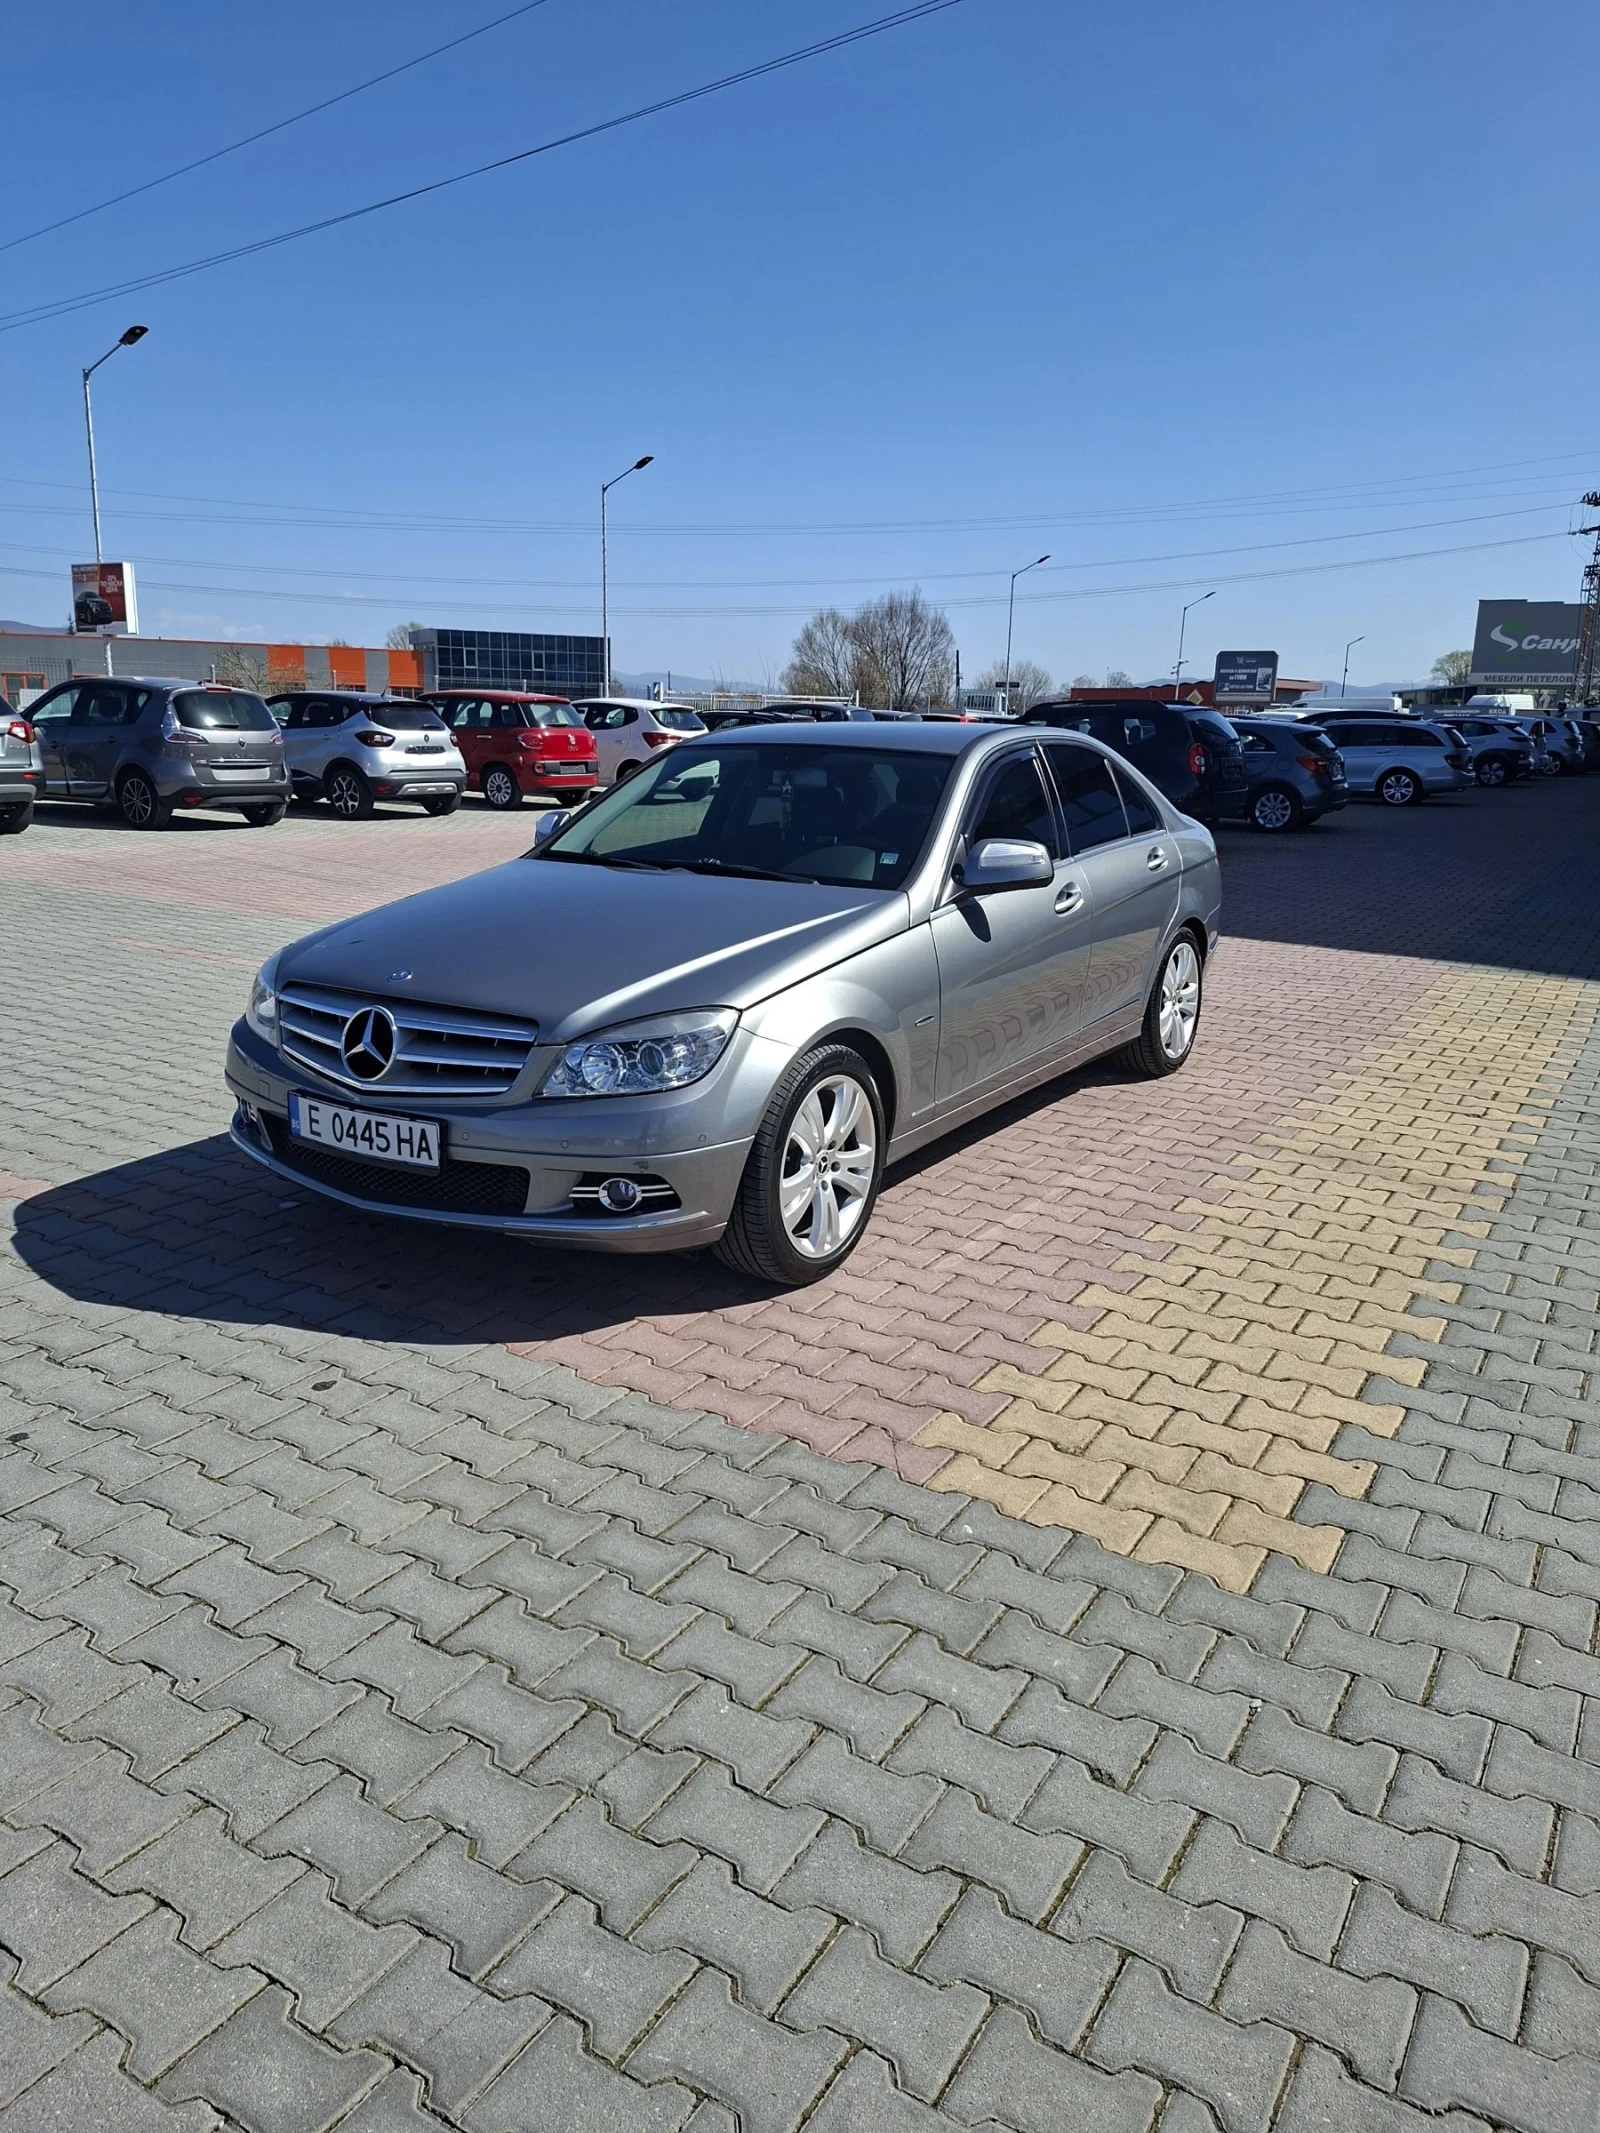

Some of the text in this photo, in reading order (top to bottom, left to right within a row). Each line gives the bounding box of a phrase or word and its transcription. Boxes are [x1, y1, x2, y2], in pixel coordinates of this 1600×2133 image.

[1521, 635, 1581, 654] Саня
[1484, 675, 1524, 683] МЕБЕЛИ
[308, 1104, 433, 1161] E 0445 HA
